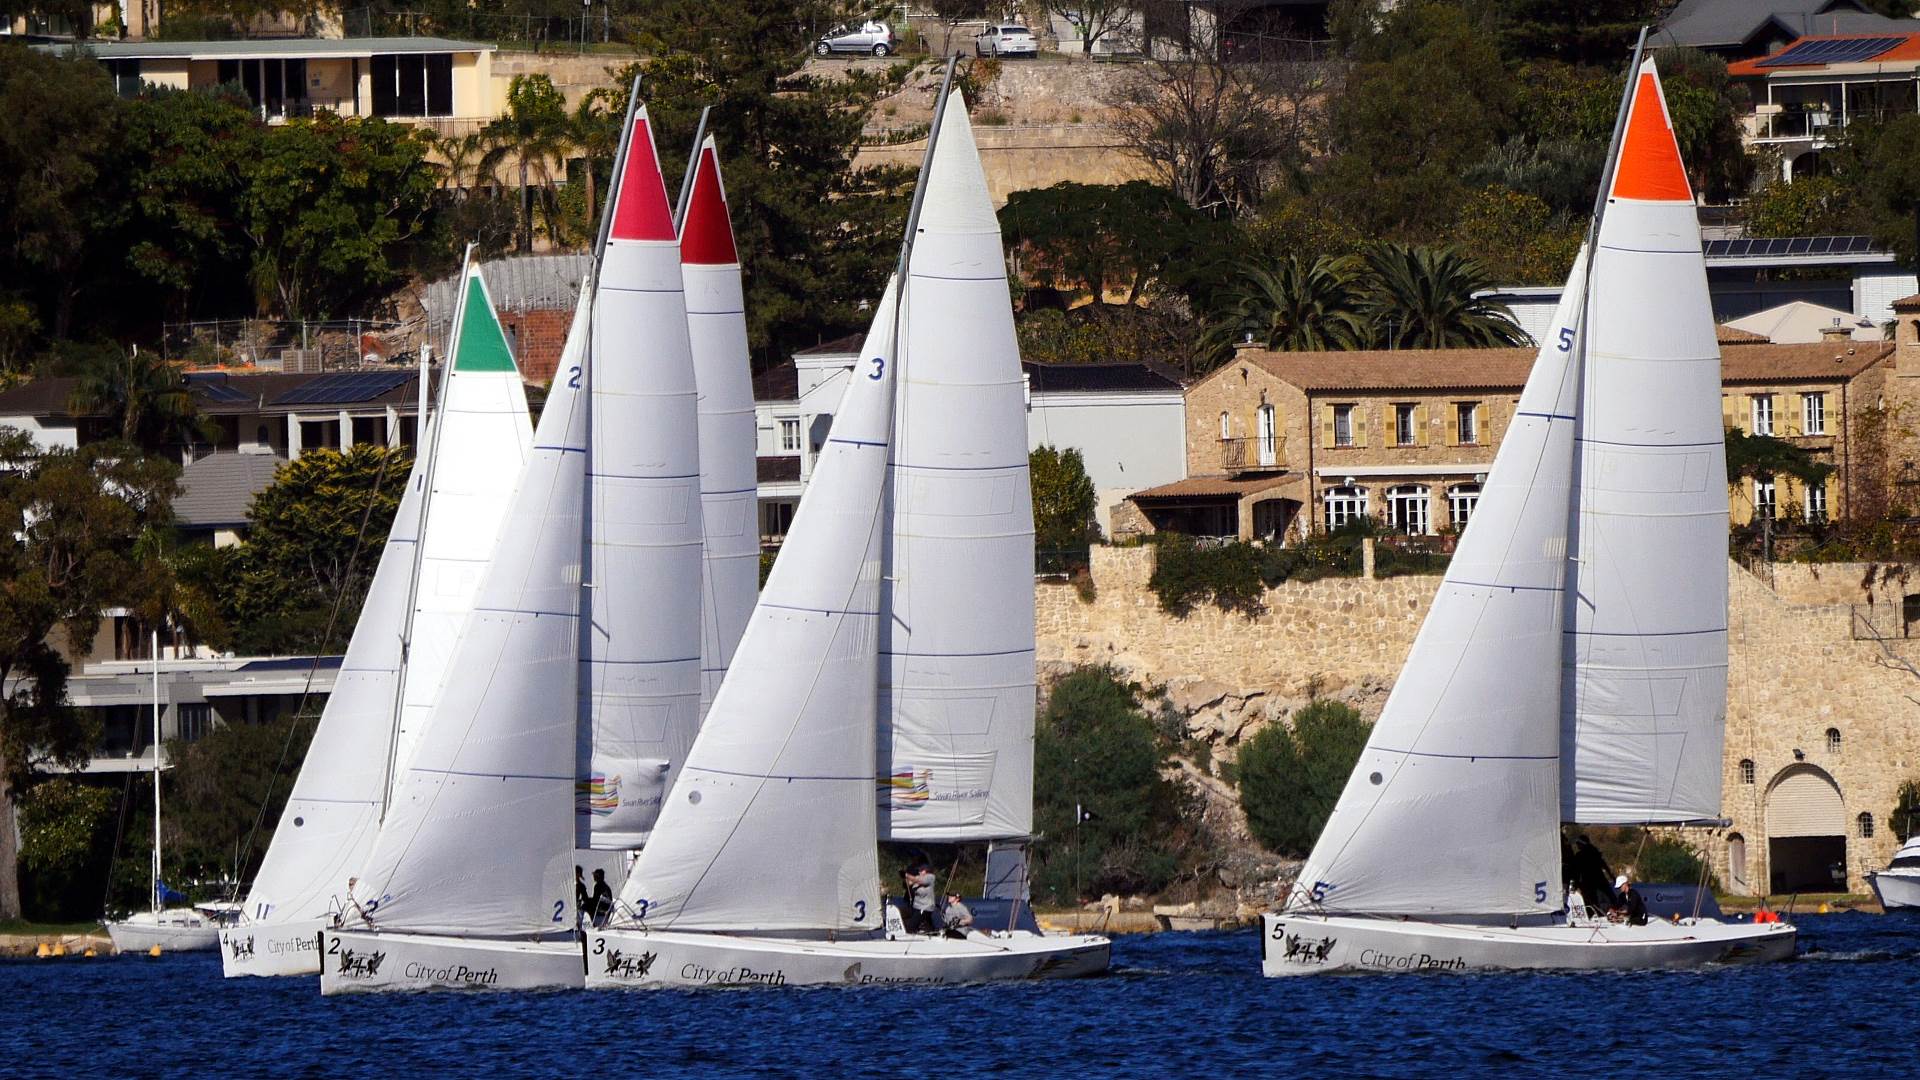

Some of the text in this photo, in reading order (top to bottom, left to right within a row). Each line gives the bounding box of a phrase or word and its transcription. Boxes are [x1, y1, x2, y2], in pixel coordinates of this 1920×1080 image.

[1557, 327, 1576, 352] 5
[568, 366, 582, 389] 2
[869, 358, 885, 381] 3
[1311, 881, 1329, 903] 5
[1535, 881, 1547, 904] 5
[552, 900, 565, 923] 2
[631, 899, 649, 919] 3
[854, 900, 866, 922] 3
[222, 933, 229, 947] 4
[1272, 923, 1286, 940] 5
[267, 936, 320, 956] City of Perth
[327, 937, 341, 955] 2
[592, 938, 606, 955] 3
[1360, 949, 1395, 968] City
[1396, 953, 1417, 969] of
[405, 962, 498, 984] City of Perth
[681, 963, 716, 983] City
[717, 967, 737, 982] of
